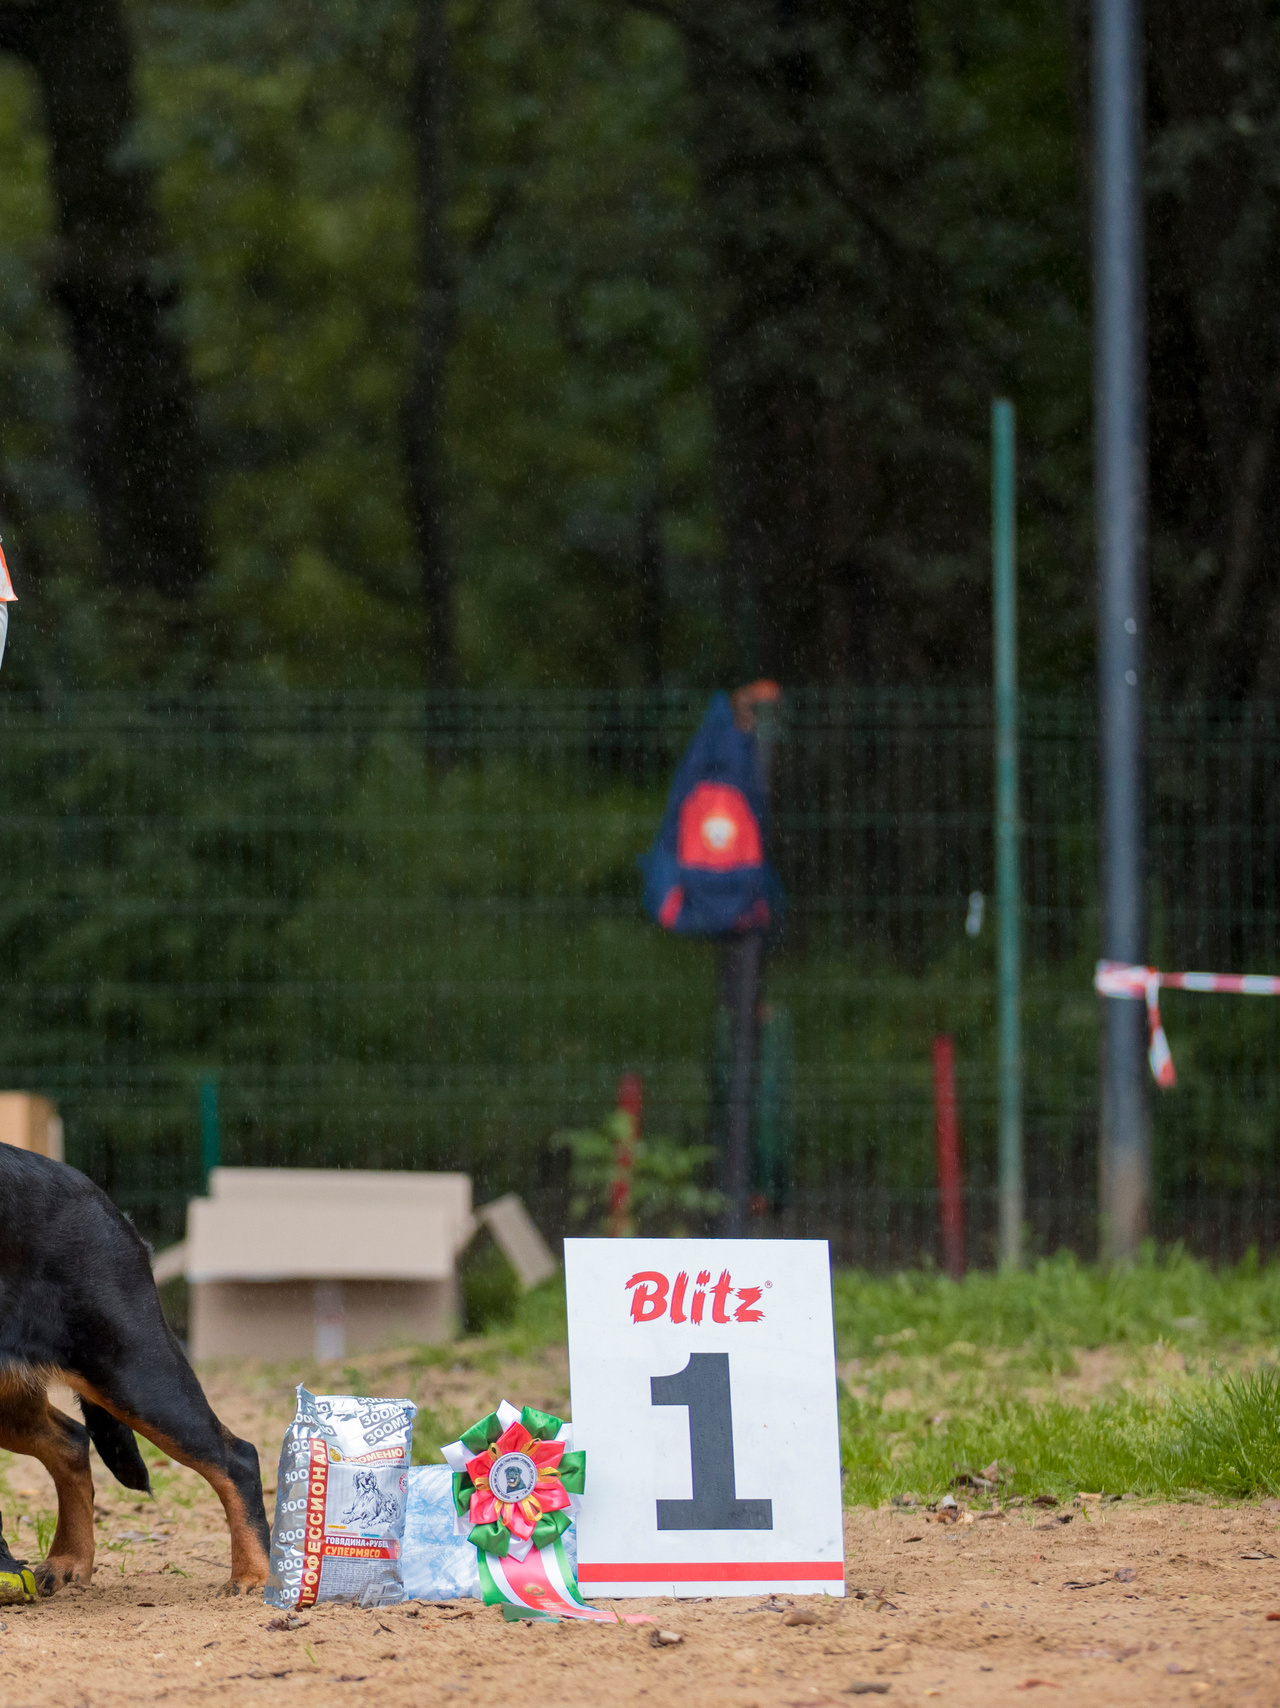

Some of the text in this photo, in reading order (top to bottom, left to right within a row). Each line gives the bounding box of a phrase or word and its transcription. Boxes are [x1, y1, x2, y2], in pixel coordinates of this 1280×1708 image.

[624, 1268, 767, 1326] Blitz
[650, 1352, 774, 1531] 1
[324, 1545, 381, 1558] СУПЕРМЯСО
